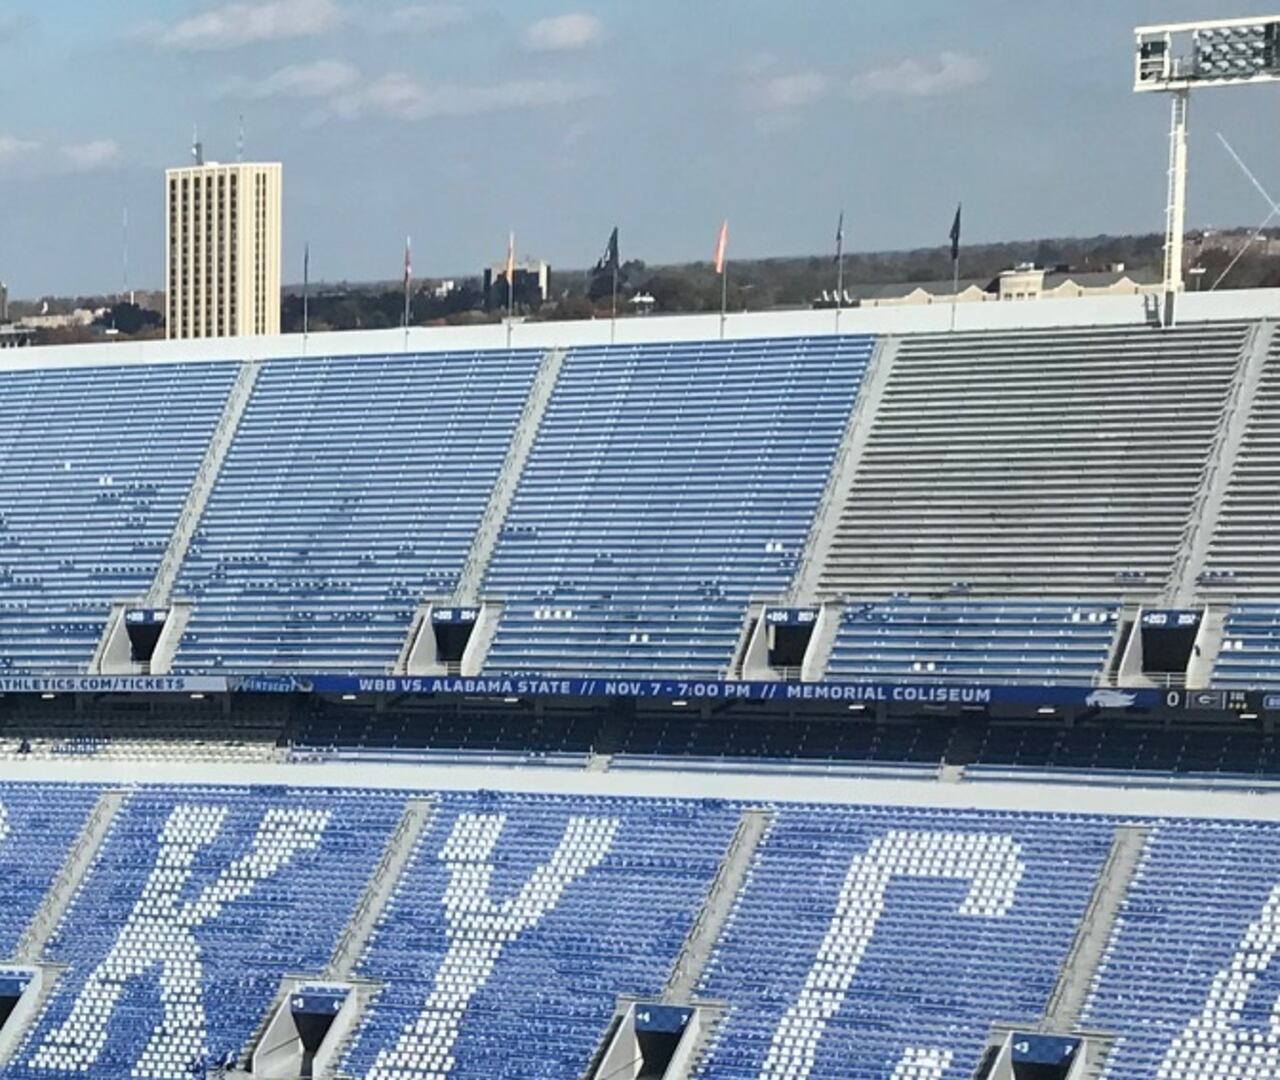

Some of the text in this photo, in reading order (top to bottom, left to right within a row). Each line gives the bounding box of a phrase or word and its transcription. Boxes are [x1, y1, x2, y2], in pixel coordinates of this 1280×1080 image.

[359, 679, 397, 691] WBB
[401, 679, 427, 691] VS.
[432, 679, 513, 693] ALABAMA
[517, 681, 570, 694] STATE
[605, 682, 644, 696] NOV.
[650, 683, 660, 695] 7
[678, 684, 719, 696] 7:00
[724, 685, 750, 697] PM
[787, 685, 886, 699] MEMORIAL
[893, 687, 990, 701] COLISEUM
[1167, 691, 1179, 706] 0
